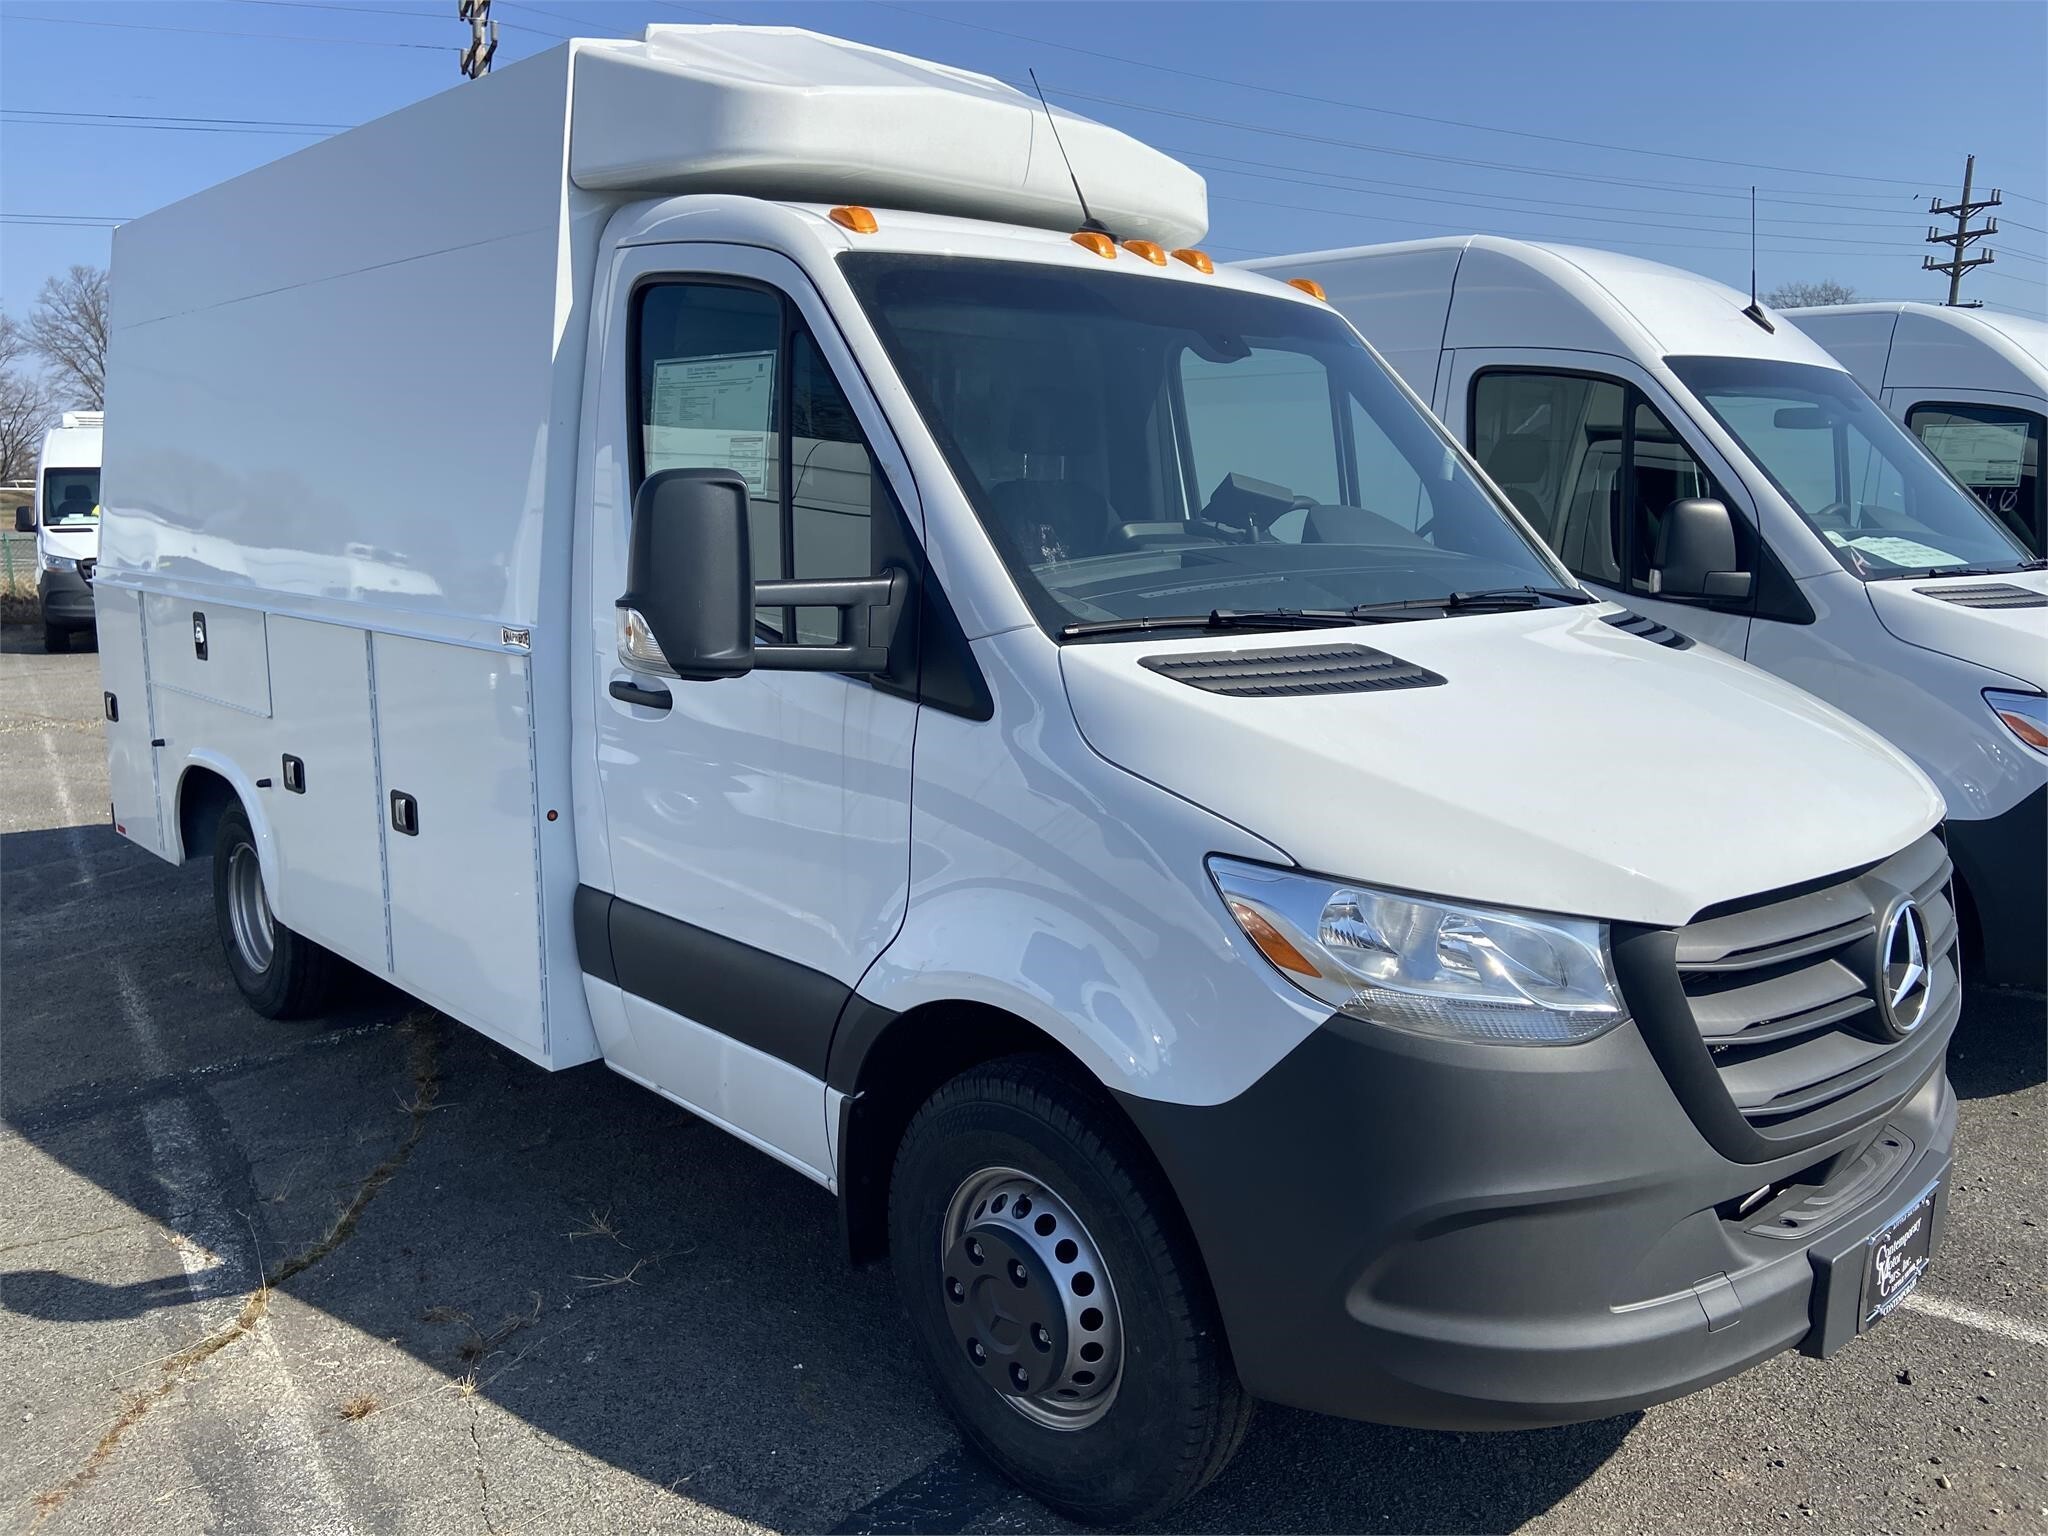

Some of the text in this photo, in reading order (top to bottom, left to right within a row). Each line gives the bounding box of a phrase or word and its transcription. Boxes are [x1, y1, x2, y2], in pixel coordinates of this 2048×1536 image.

[1876, 1217, 1921, 1270] Contemporary
[1877, 1252, 1902, 1285] Motor
[1883, 1277, 1917, 1316] CONTEMPORARY
